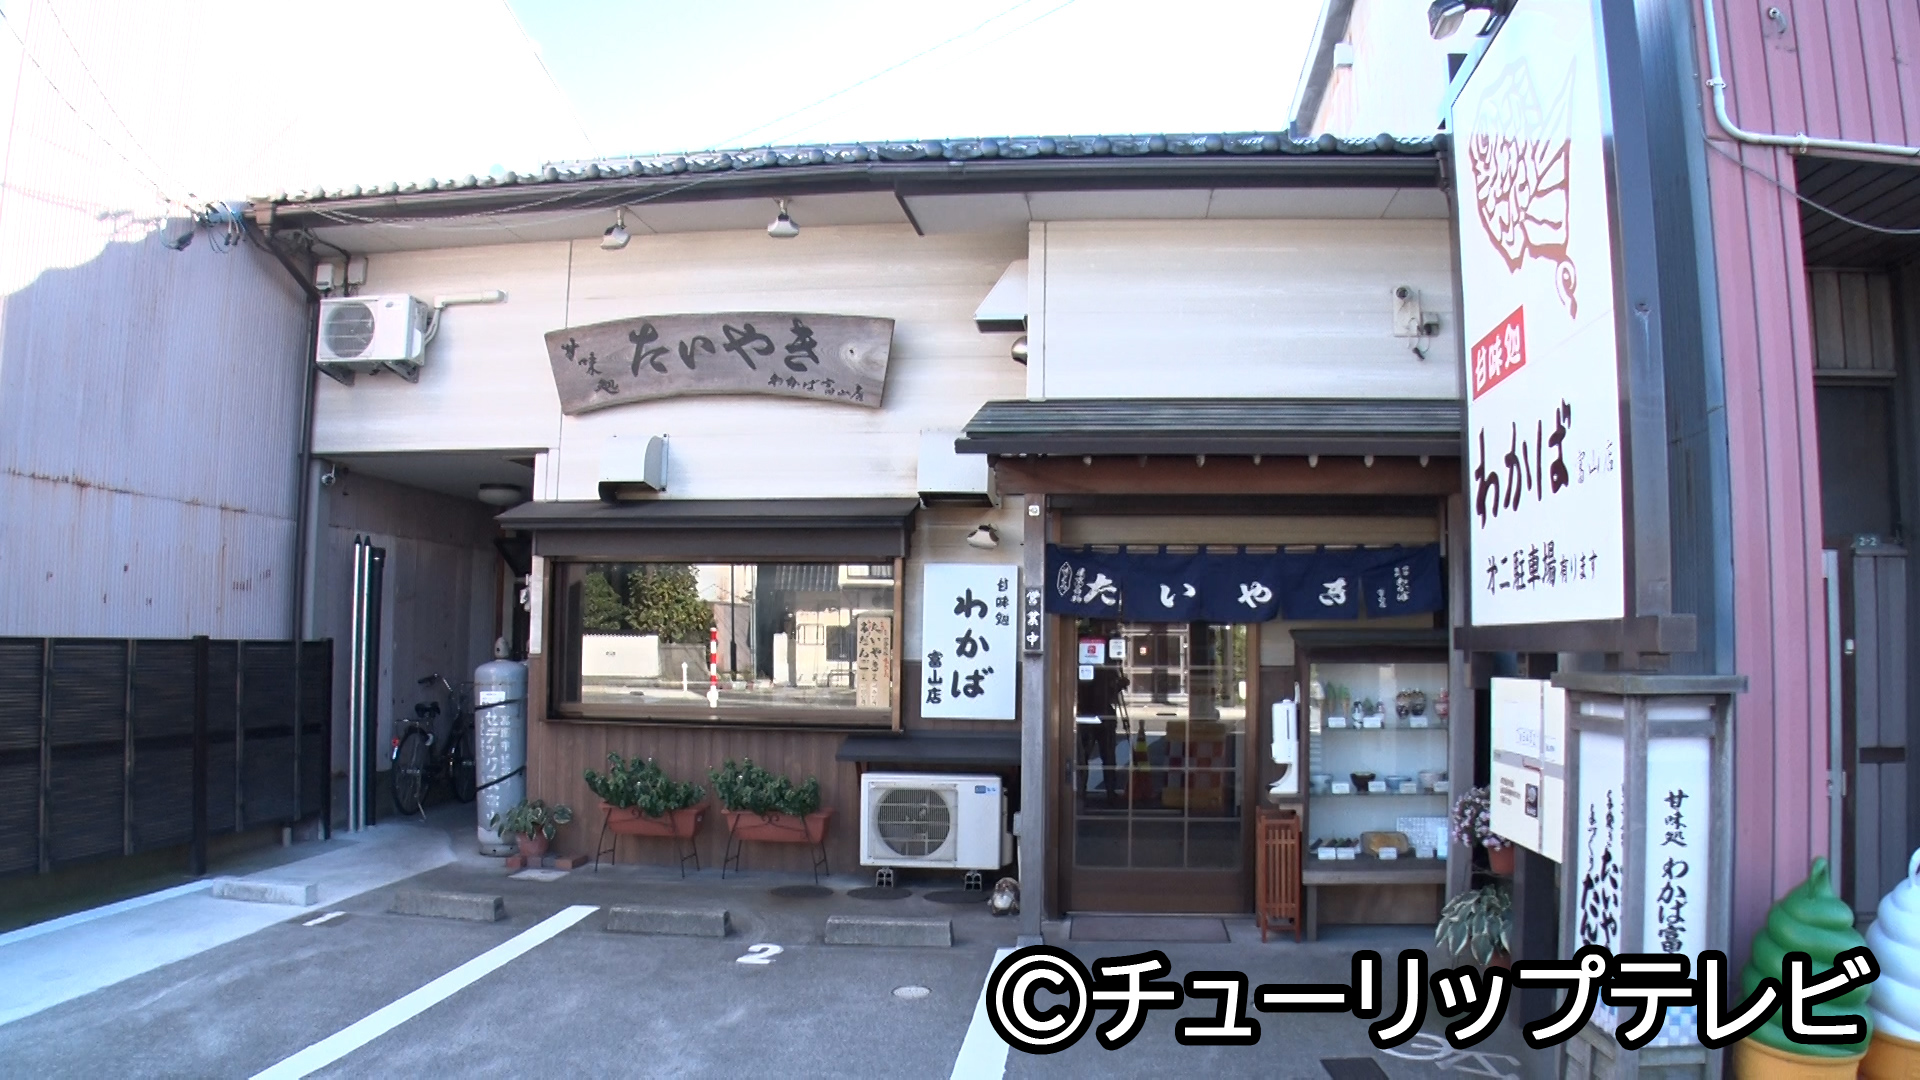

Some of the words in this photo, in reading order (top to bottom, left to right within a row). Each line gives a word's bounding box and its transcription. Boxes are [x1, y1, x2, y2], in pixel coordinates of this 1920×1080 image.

[561, 337, 620, 395] 甘味処
[628, 318, 820, 377] たいやき
[1474, 322, 1522, 392] 甘味処
[1474, 397, 1572, 529] わかば
[994, 577, 1010, 627] 甘味処
[1025, 590, 1041, 648] 営業中
[1083, 572, 1348, 609] たいやき
[950, 587, 995, 699] わかば
[925, 649, 944, 705] 富山店
[1660, 789, 1689, 848] 甘味処
[735, 943, 785, 965] 2
